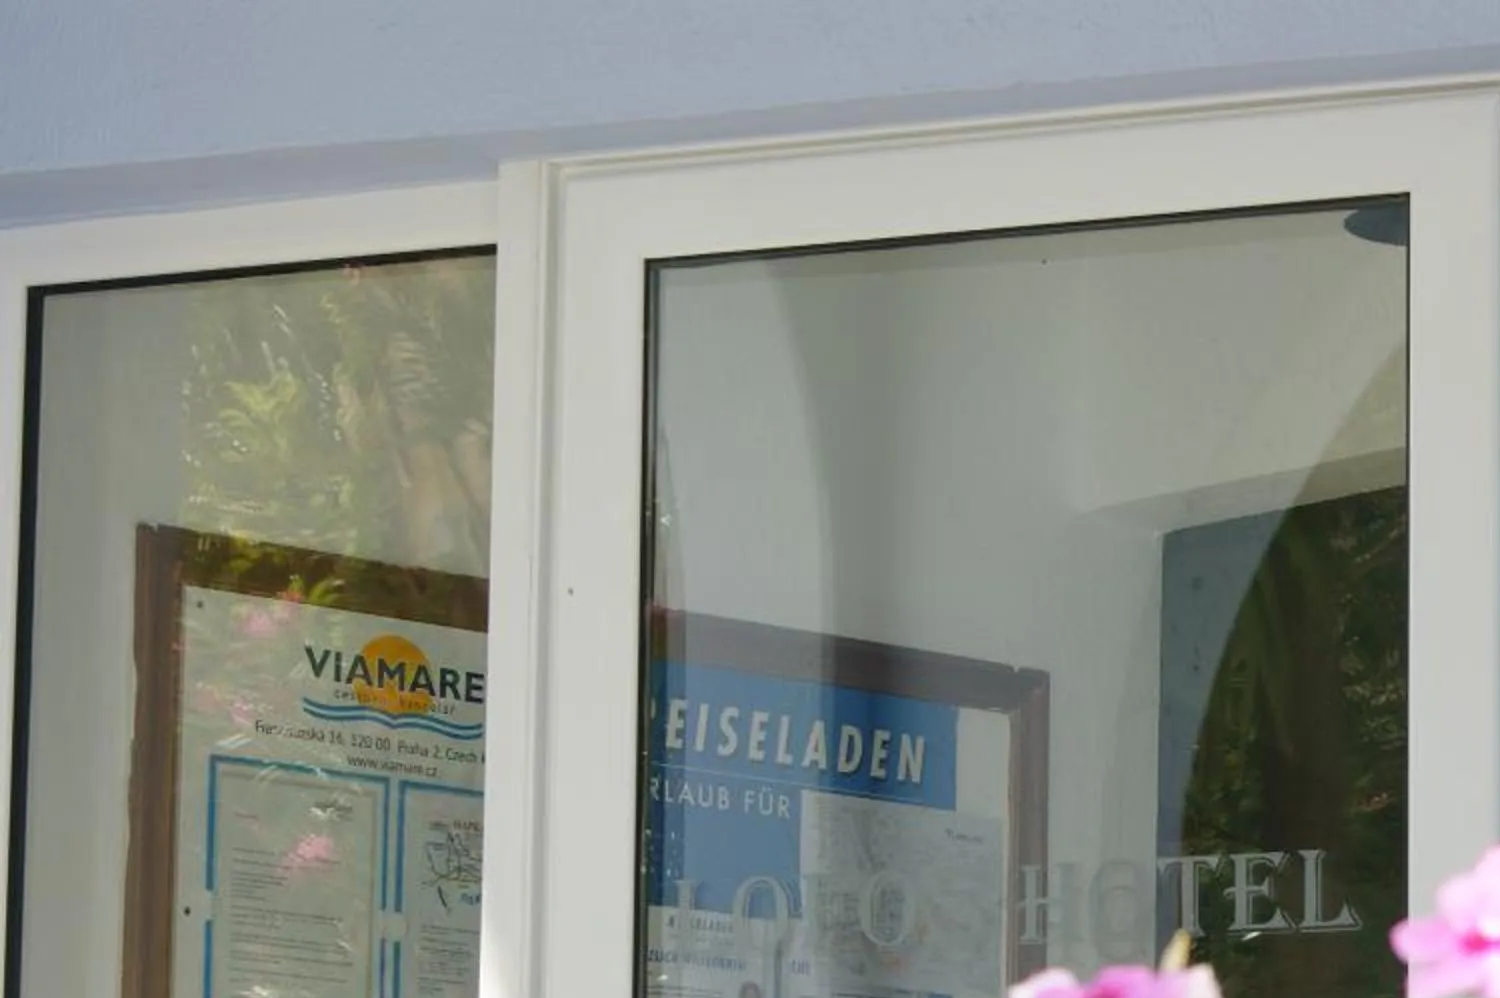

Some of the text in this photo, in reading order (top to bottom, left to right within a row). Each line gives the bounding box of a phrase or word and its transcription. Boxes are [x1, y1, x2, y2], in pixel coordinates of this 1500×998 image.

[304, 645, 485, 704] VIAMARE
[744, 787, 790, 819] FÜR
[1017, 848, 1362, 944] HOTEL
